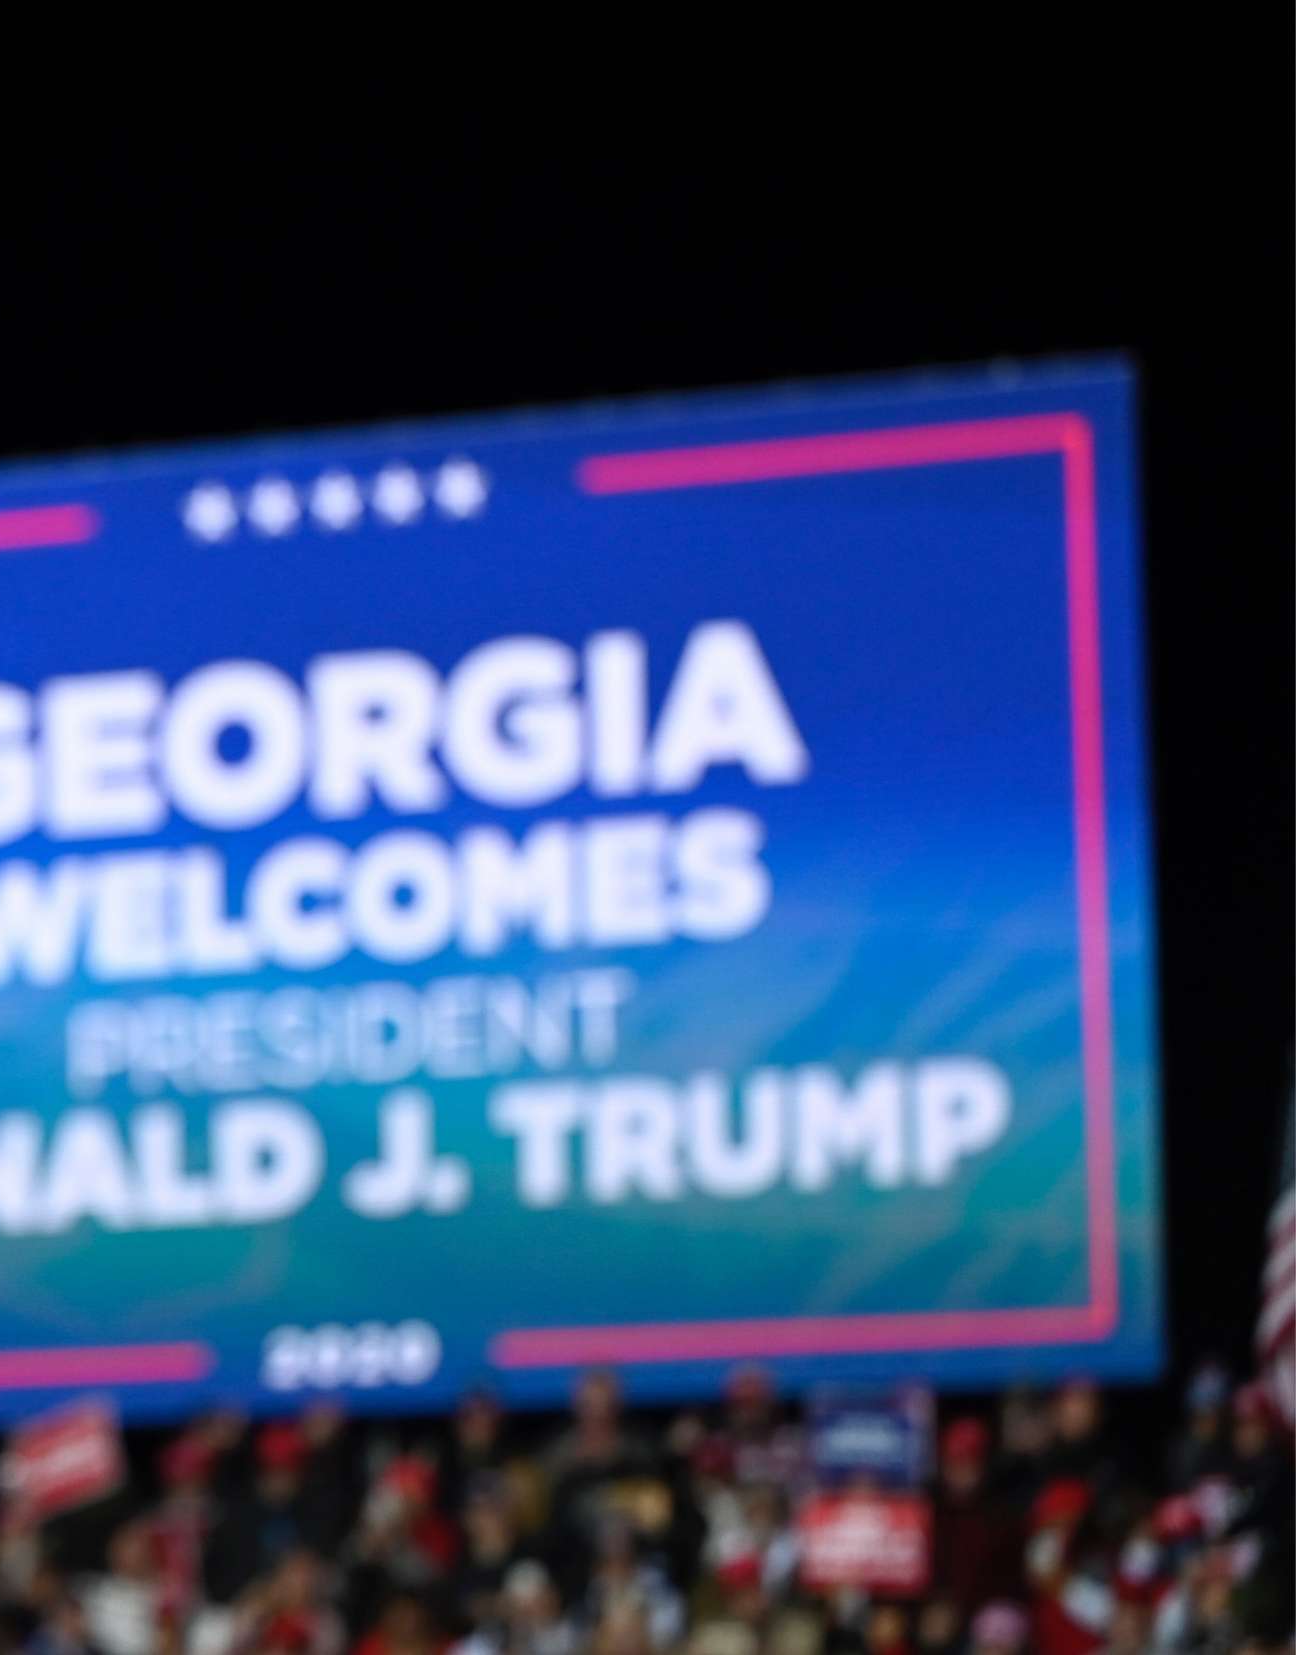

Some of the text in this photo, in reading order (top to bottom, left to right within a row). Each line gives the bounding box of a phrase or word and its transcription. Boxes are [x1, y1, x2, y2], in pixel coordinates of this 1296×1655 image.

[70, 970, 629, 1096] PRESIDENT
[347, 1093, 469, 1216] J.
[494, 1059, 1010, 1203] TRUMP
[263, 1320, 440, 1389] 2020
